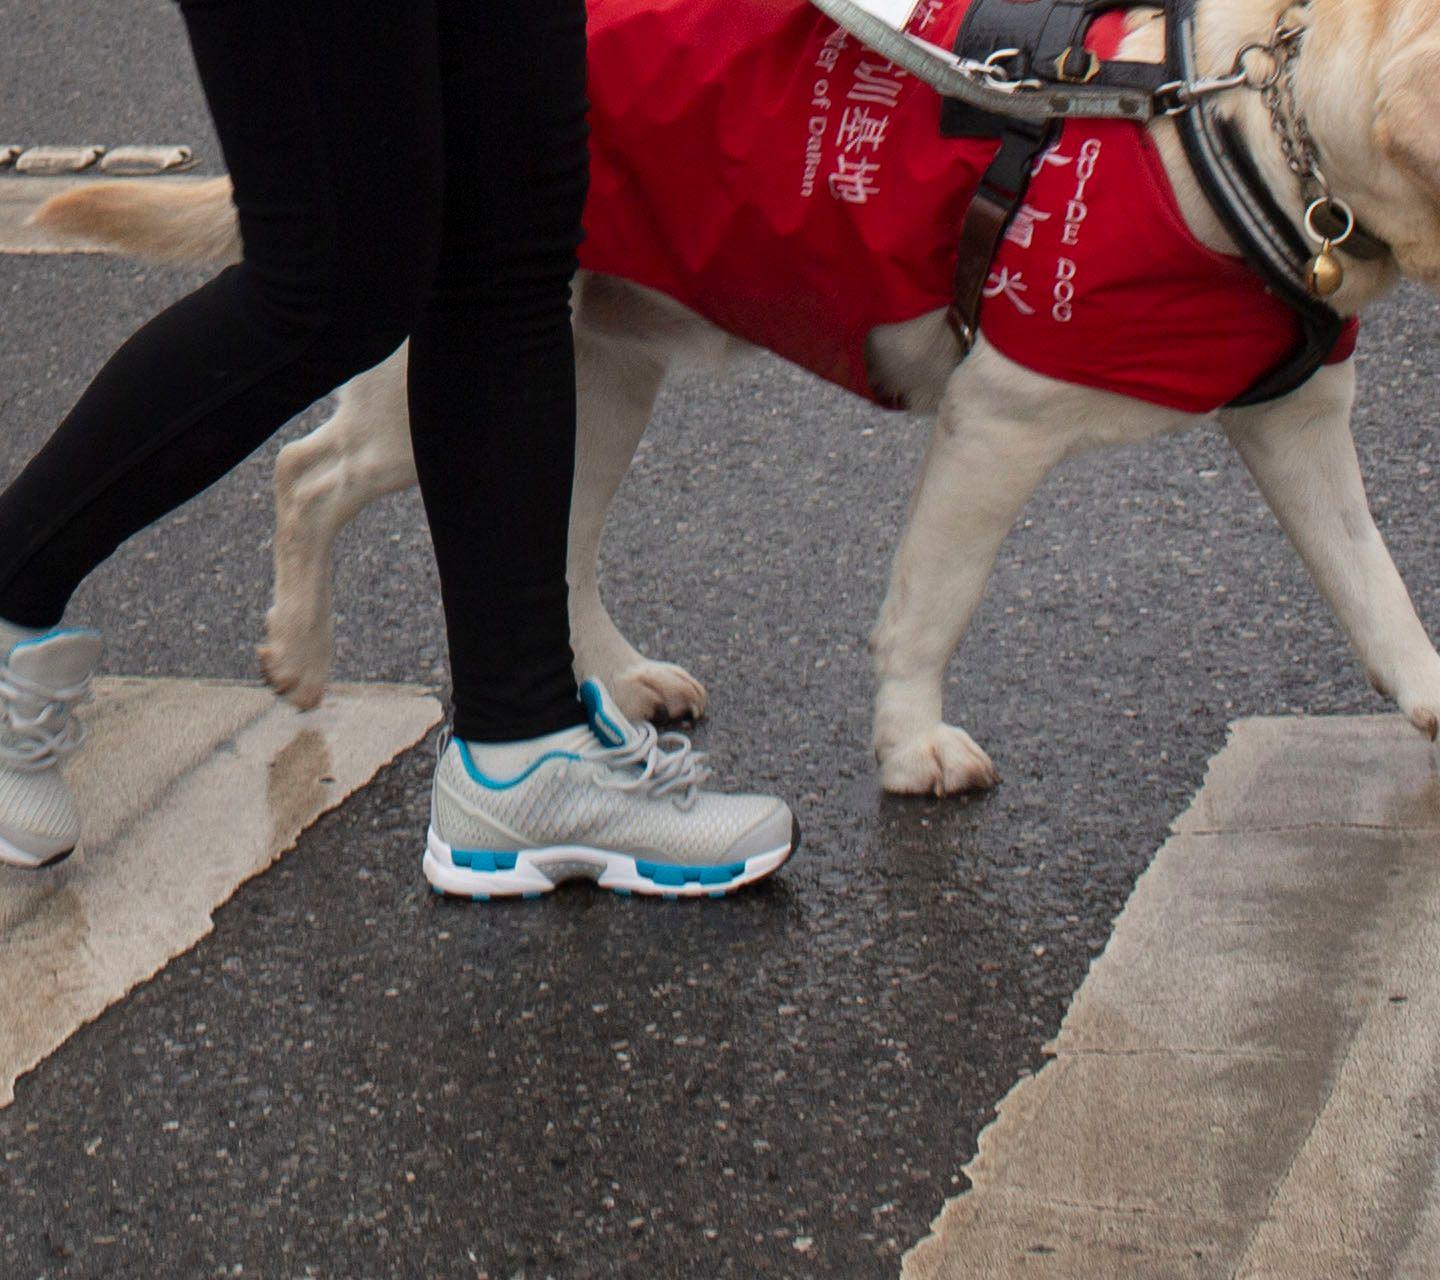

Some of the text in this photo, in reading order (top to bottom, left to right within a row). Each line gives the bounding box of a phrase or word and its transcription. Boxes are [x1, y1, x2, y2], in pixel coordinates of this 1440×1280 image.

[811, 78, 831, 110] of
[828, 46, 908, 204] 训基地
[800, 115, 827, 197] Dalian
[1052, 138, 1102, 322] GUIDE DOG
